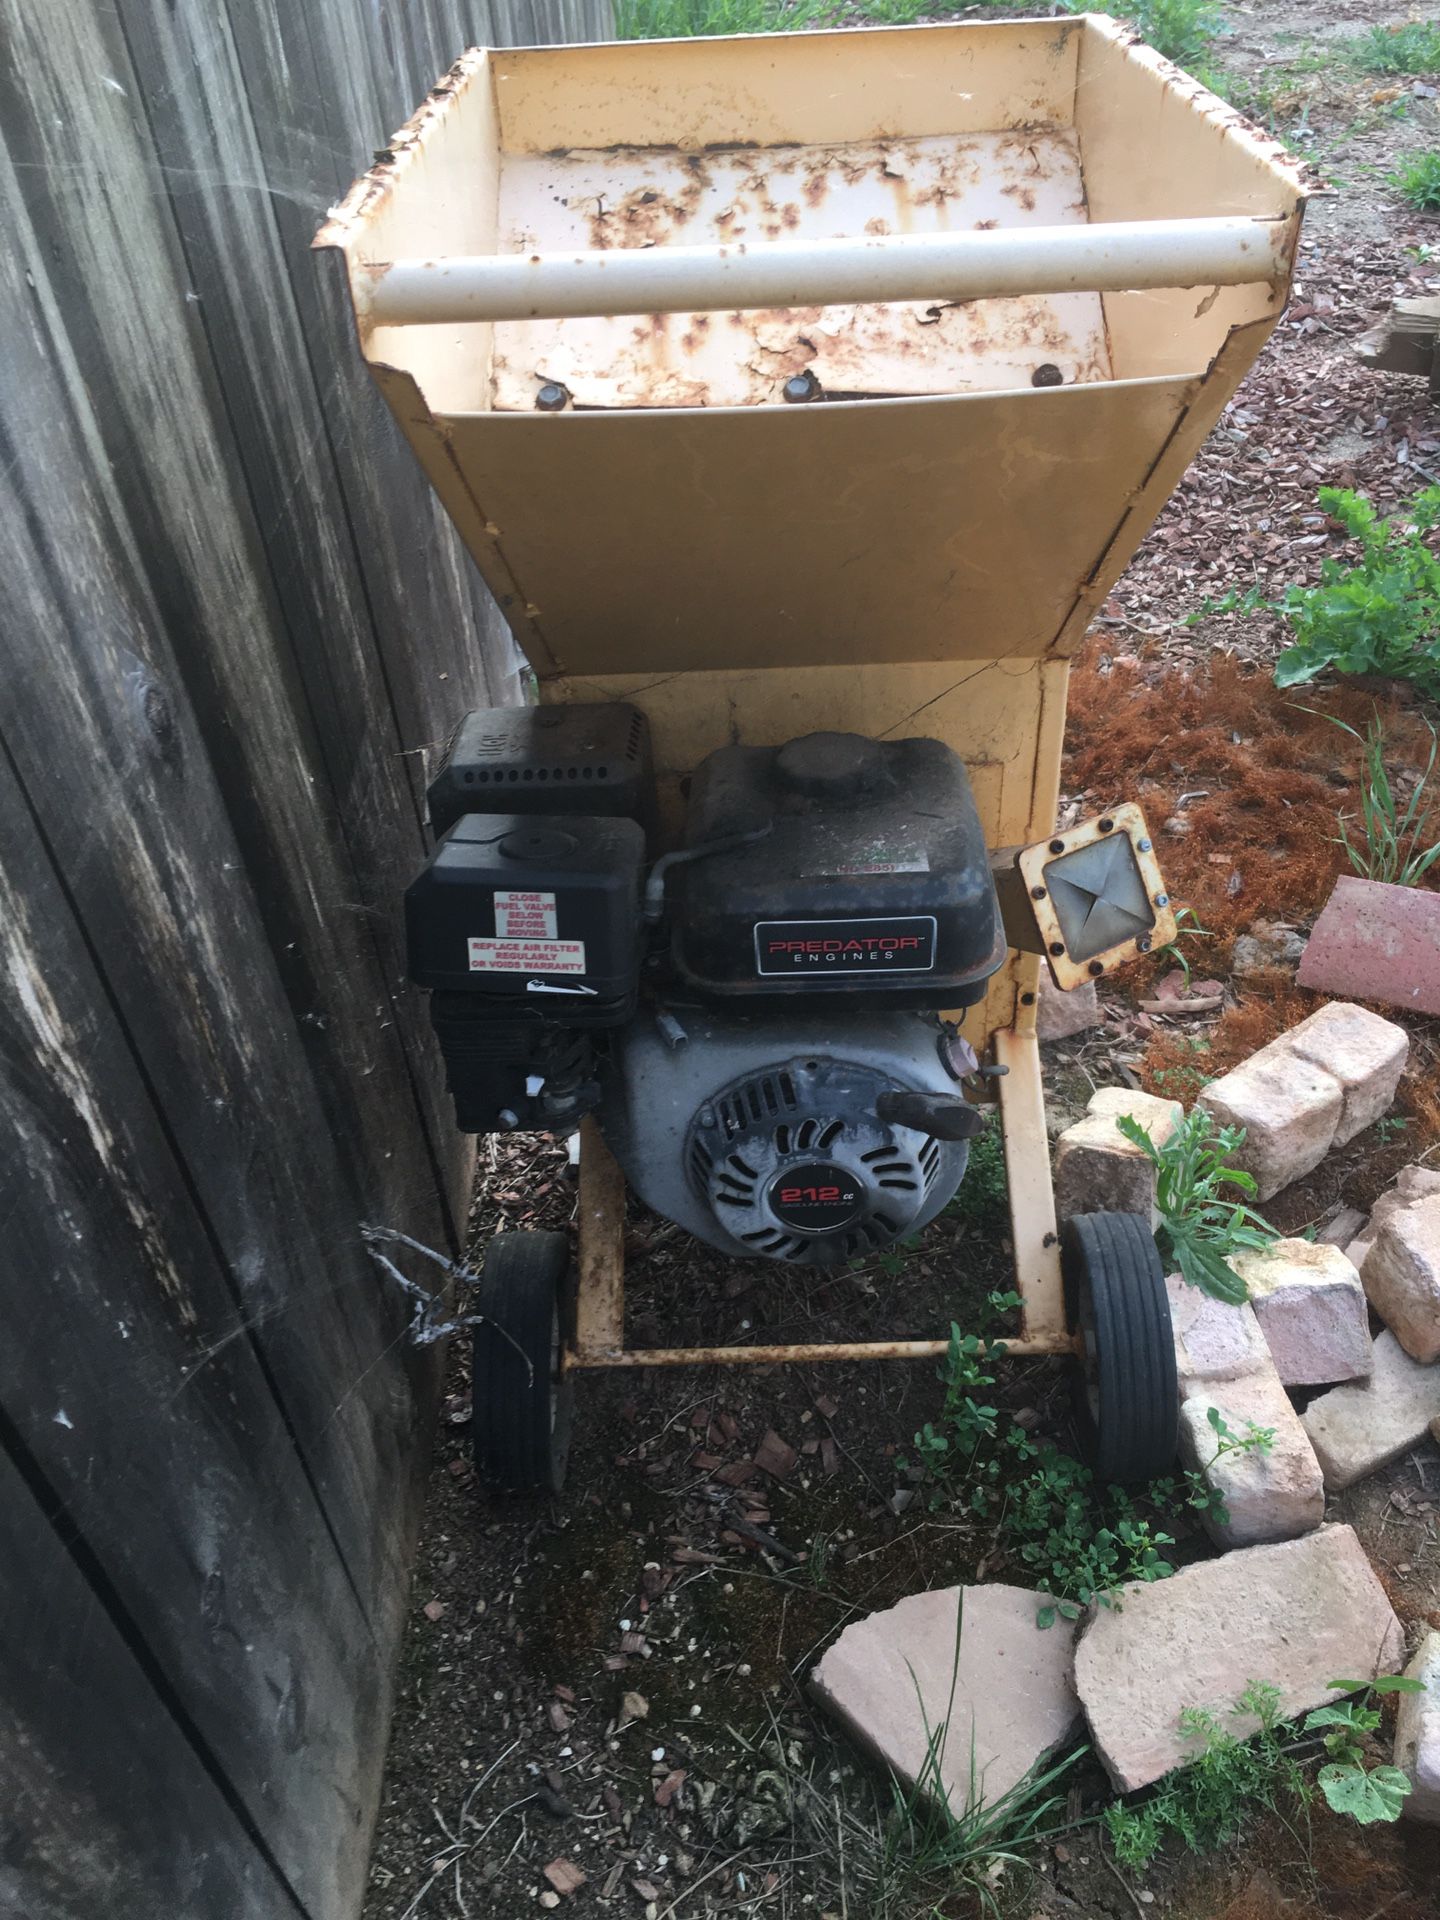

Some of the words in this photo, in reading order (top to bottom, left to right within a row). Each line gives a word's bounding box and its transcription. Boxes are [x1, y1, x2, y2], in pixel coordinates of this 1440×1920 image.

[508, 894, 542, 902] CLOSE
[495, 902, 521, 910] FUEL
[524, 903, 556, 911] VALVE
[508, 911, 544, 919] BELOW
[507, 920, 546, 928] BEFORE
[507, 929, 547, 937] MOVING
[472, 943, 520, 951] REPLACE
[543, 944, 580, 952] FILTER
[769, 937, 918, 953] PREDATOR
[495, 952, 558, 960] REGULARLY
[794, 951, 893, 962] ENGINES
[471, 960, 486, 968] OR
[489, 961, 521, 969] VOIDS
[524, 962, 583, 970] WARRANTY
[781, 1186, 840, 1202] 212
